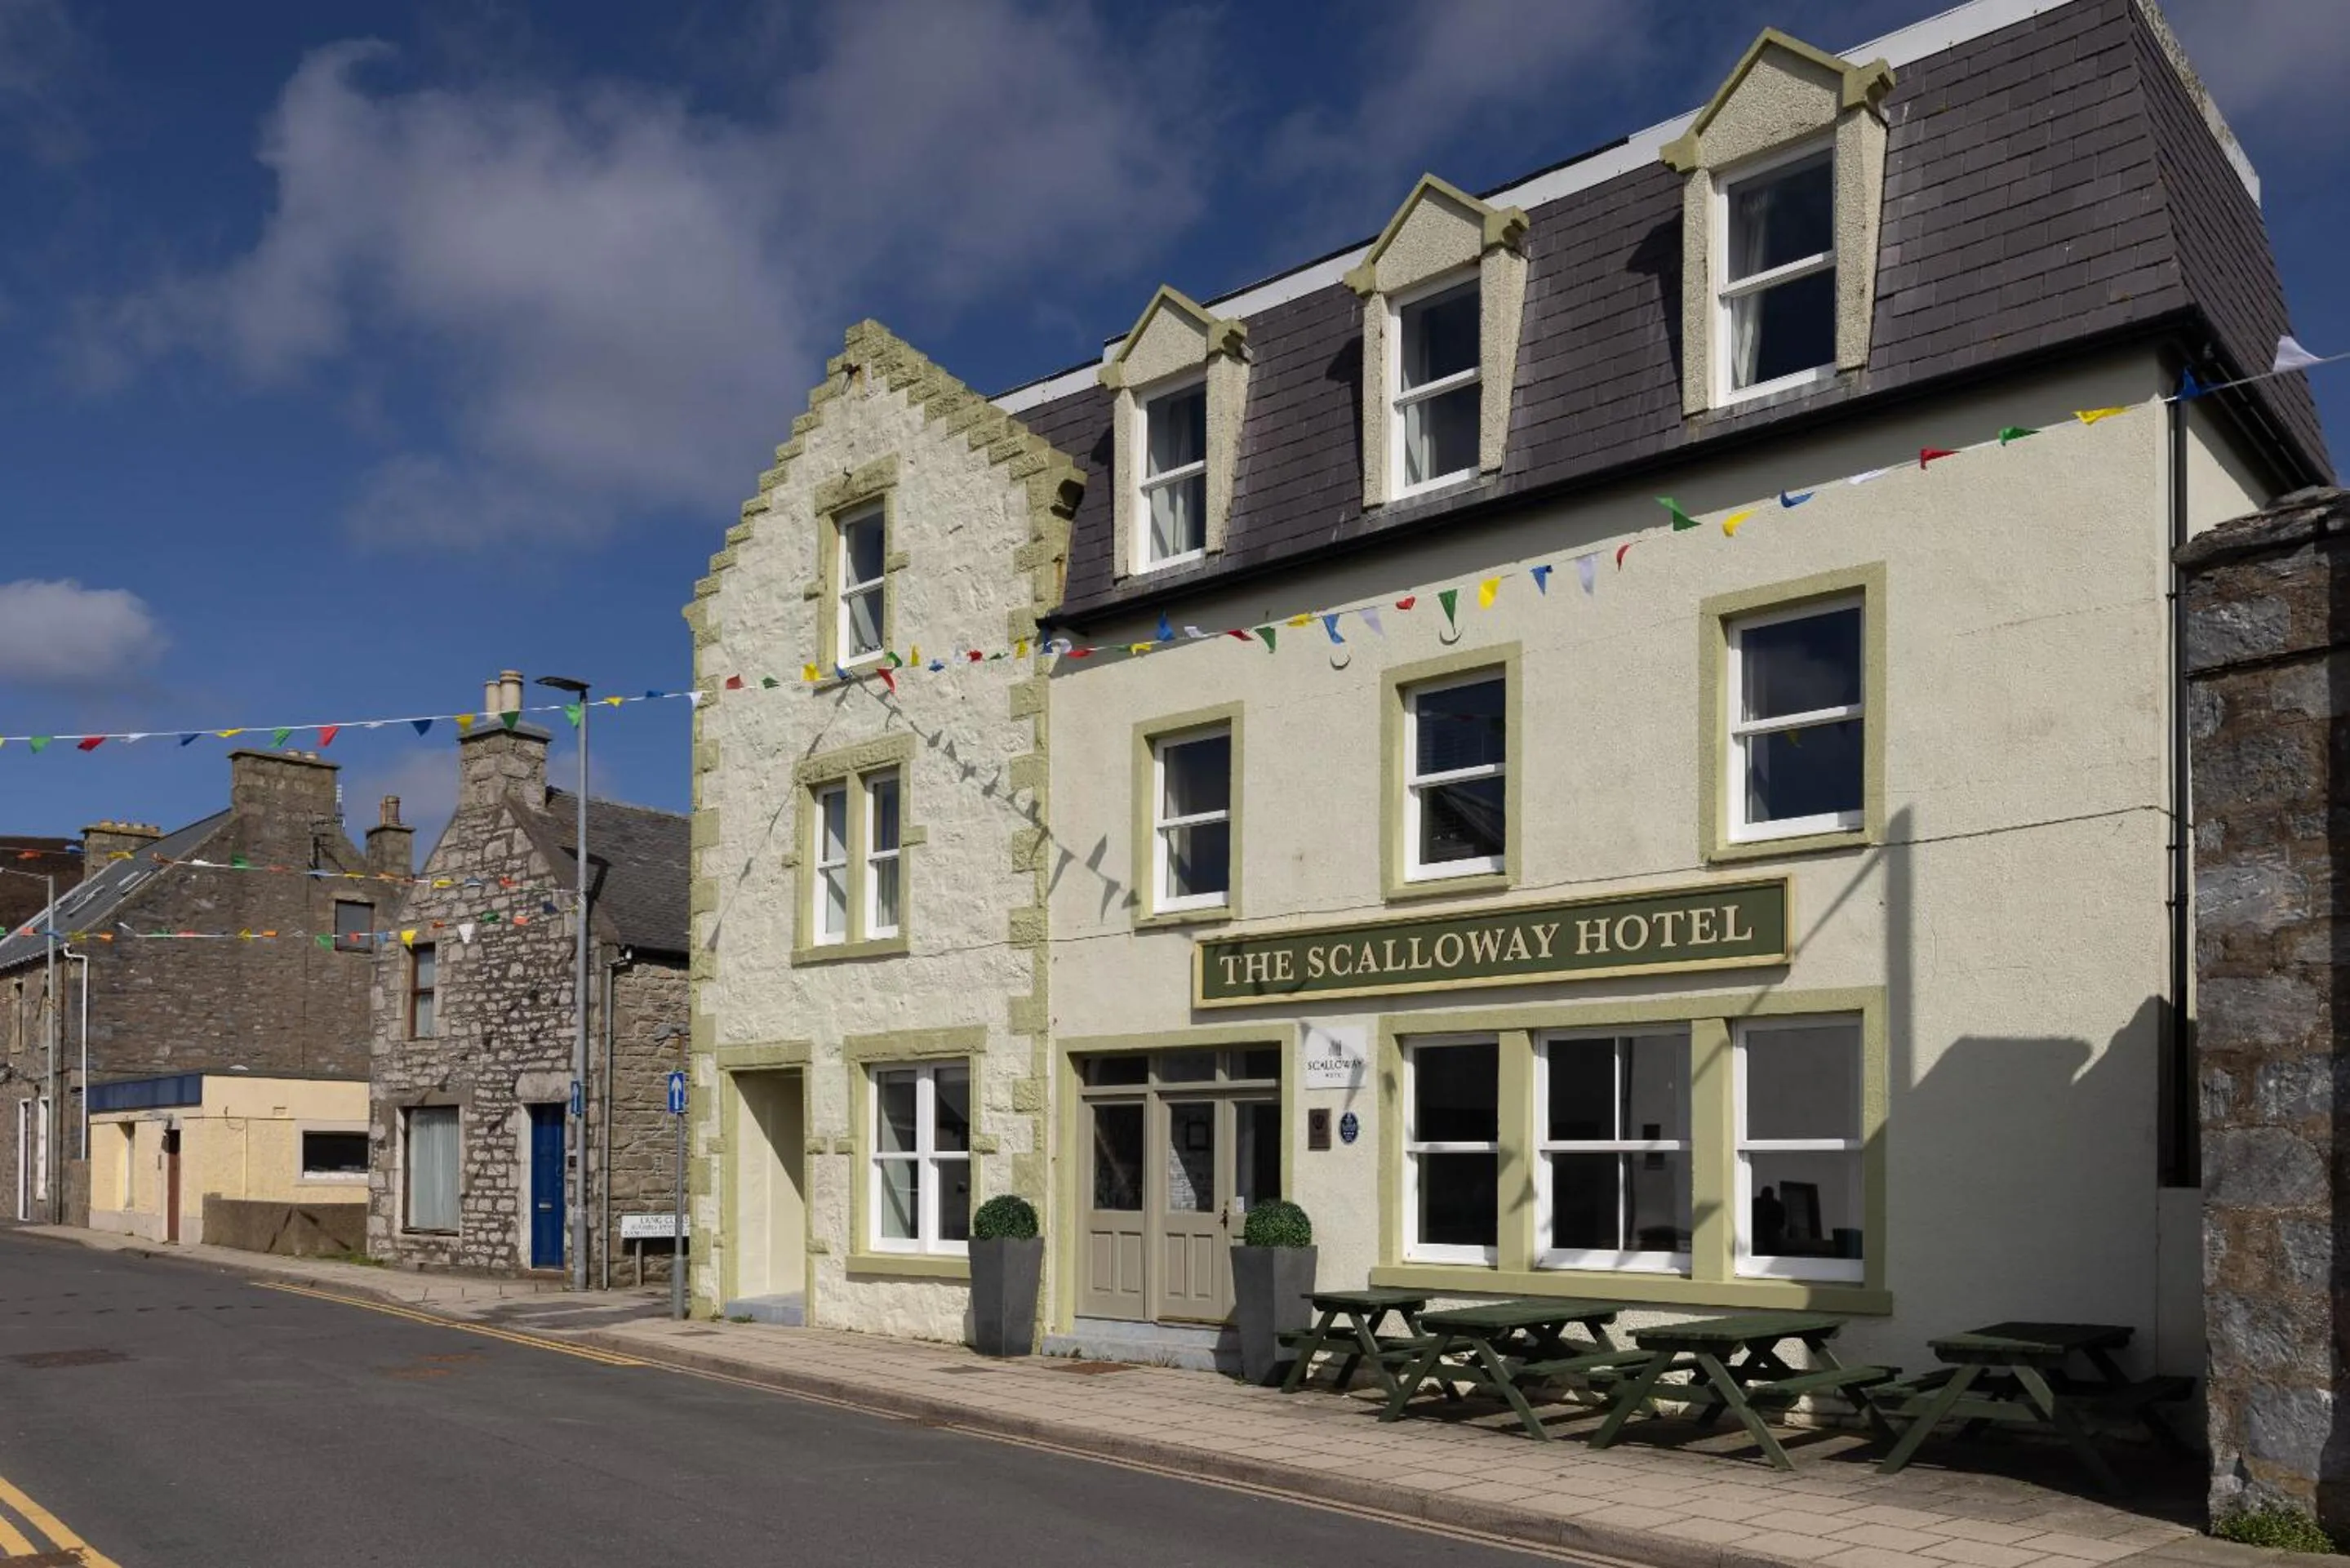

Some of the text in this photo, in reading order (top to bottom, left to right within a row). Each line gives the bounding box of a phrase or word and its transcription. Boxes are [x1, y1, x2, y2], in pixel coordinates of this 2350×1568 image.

[1219, 905, 1753, 984] THE SCALLOWAY HOTEL
